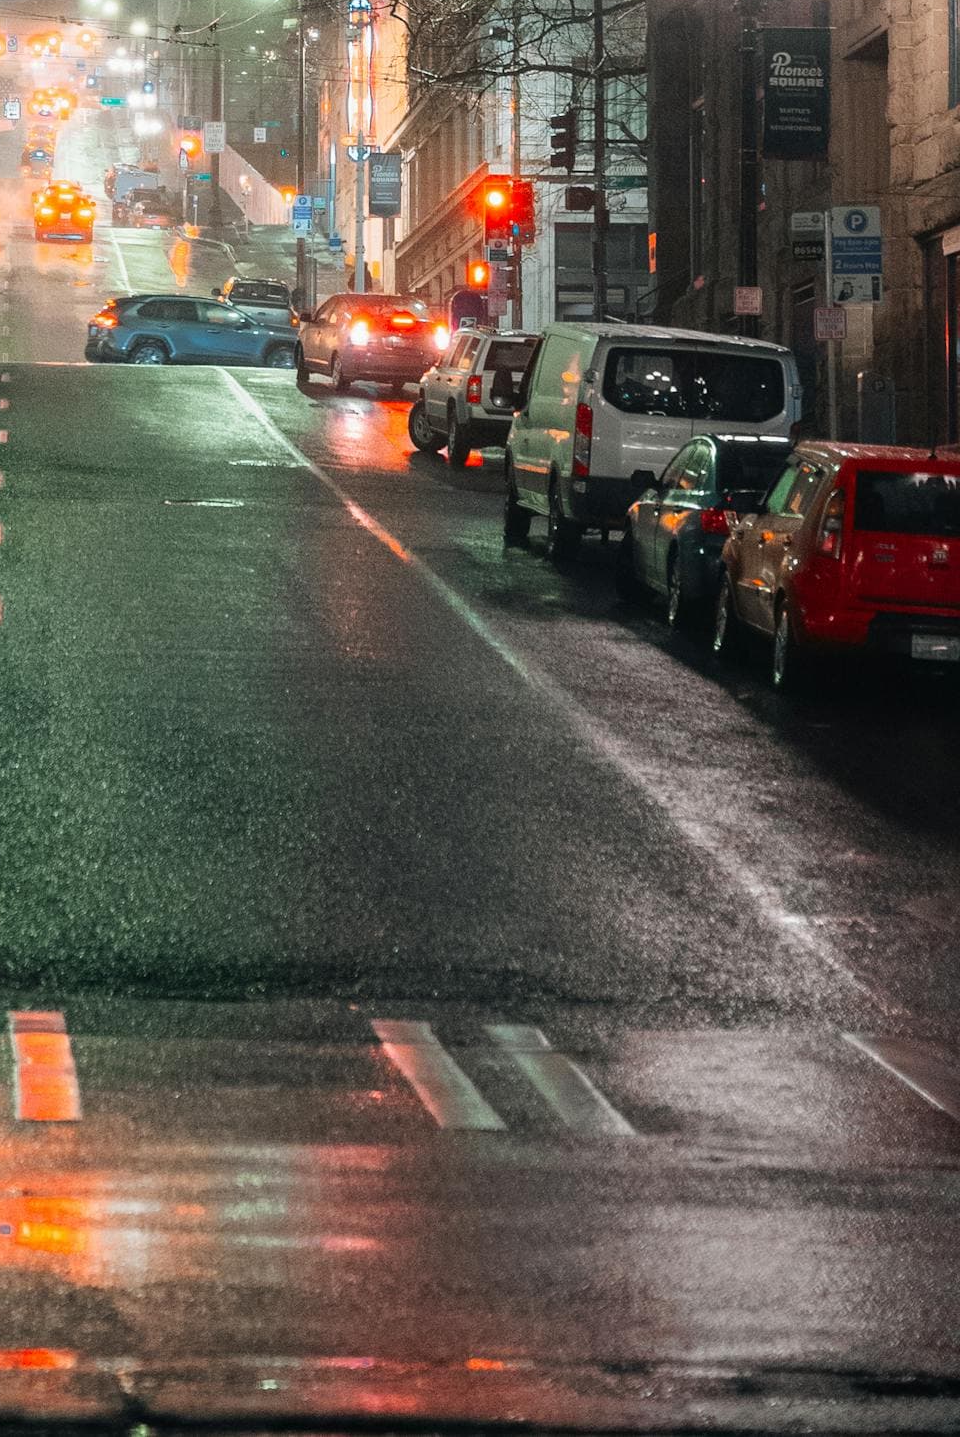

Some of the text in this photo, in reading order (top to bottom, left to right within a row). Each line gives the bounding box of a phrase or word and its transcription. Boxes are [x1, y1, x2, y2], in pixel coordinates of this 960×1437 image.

[770, 52, 824, 77] Pioneer
[769, 76, 824, 88] SQUARE
[851, 214, 863, 230] P
[835, 260, 842, 270] 2
